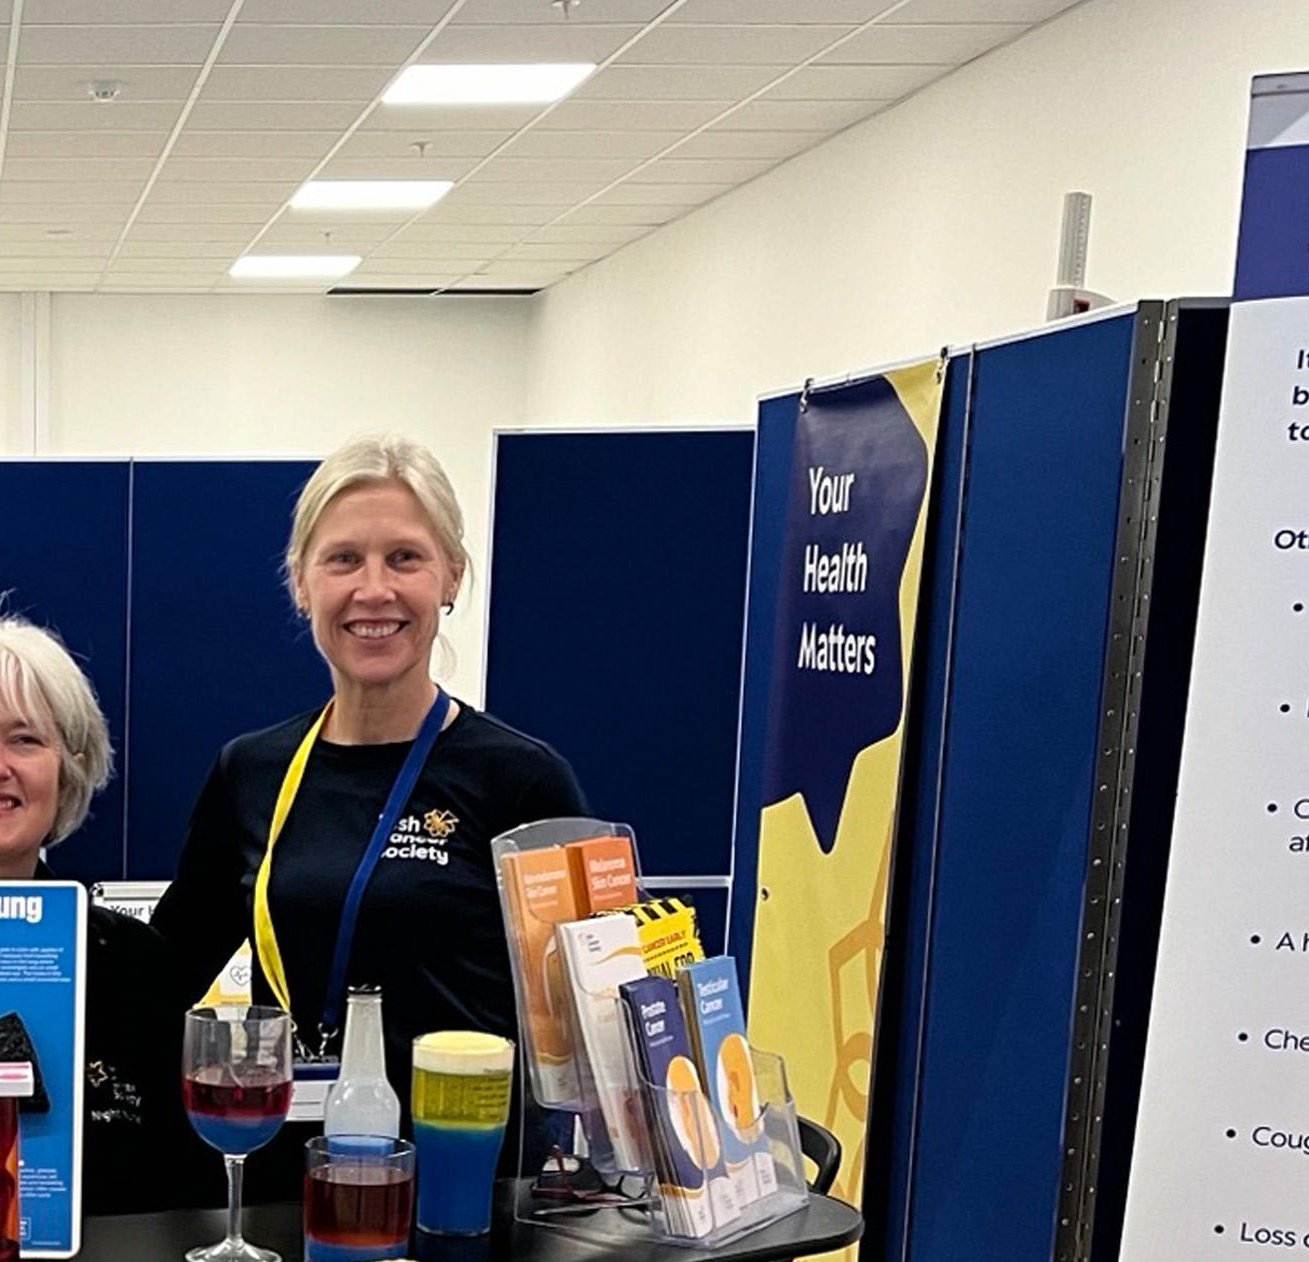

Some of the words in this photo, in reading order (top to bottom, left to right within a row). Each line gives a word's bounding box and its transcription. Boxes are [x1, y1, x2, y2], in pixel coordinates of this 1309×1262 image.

[809, 466, 854, 515] Your
[803, 542, 868, 593] Health
[798, 622, 876, 675] Matters
[380, 844, 448, 865] ociety
[1276, 932, 1295, 951] A
[1241, 1222, 1296, 1247] Loss
